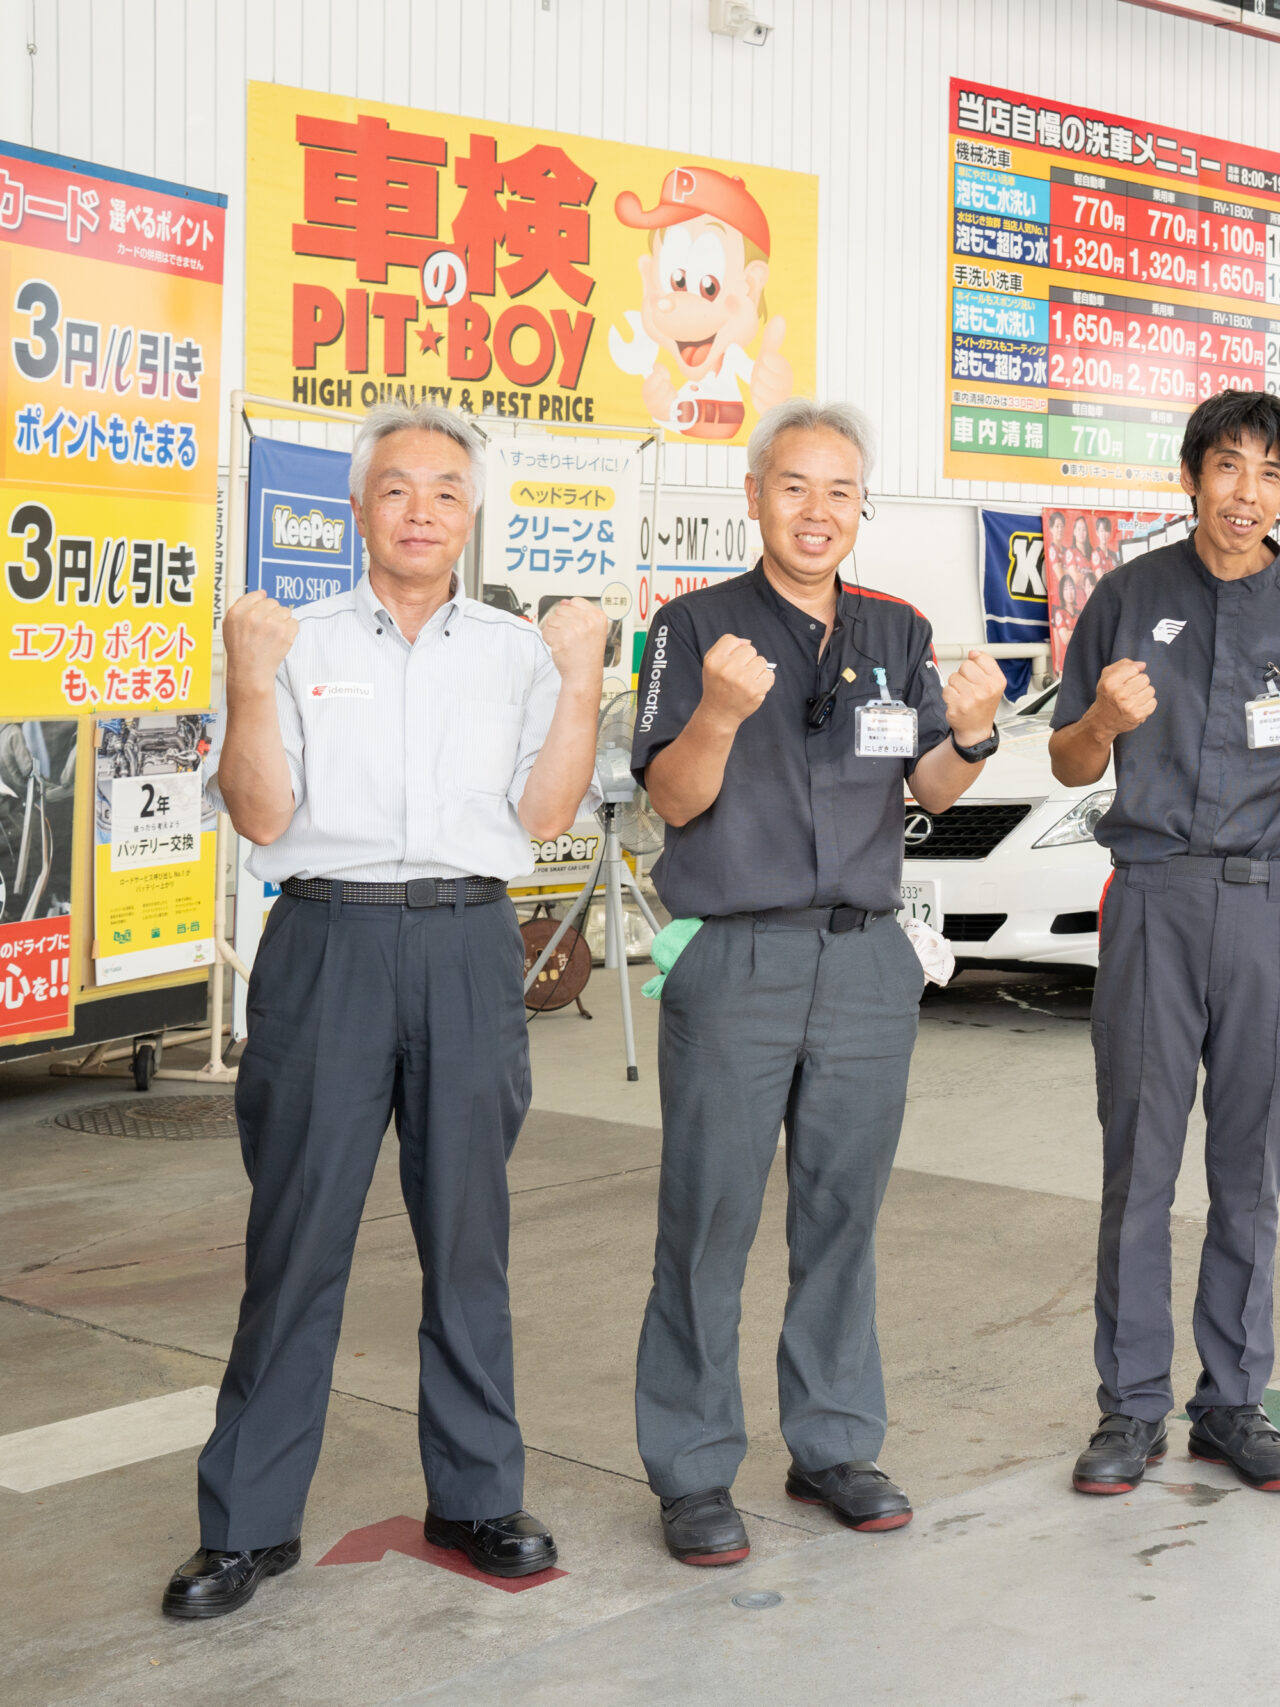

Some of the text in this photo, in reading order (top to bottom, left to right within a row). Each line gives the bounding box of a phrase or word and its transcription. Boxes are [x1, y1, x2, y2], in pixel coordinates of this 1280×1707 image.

[958, 90, 1221, 177] 当店自慢の洗車メニュー
[956, 141, 1011, 168] 機械洗車
[673, 167, 697, 203] P
[956, 179, 1036, 217] 泡もこ水洗い
[109, 198, 214, 251] 選べるポイント
[1073, 195, 1125, 232] 770円
[1148, 209, 1197, 245] 770円
[956, 225, 1048, 264] 泡もこ超はっ水
[1053, 235, 1124, 274] 1,320円
[1201, 220, 1264, 257] 1,100円
[954, 265, 1023, 293] 手洗い洗車
[1129, 248, 1197, 286] 1,320円
[1201, 261, 1264, 297] 1,650円
[955, 304, 1035, 338] 泡もこ水洗い
[1052, 310, 1124, 348] 1,650円
[1127, 321, 1196, 357] 2,200円
[954, 348, 1048, 385] 泡もこ超はっ水
[1200, 331, 1264, 367] 2,750円
[1051, 354, 1123, 391] 2,200円
[1127, 364, 1196, 398] 2,750円
[293, 376, 352, 408] HIGH
[460, 388, 474, 413] &
[539, 395, 594, 423] PRICE
[17, 408, 197, 467] ポイントもたまる
[954, 416, 1043, 449] 車内清掃
[1071, 424, 1122, 457] 770円
[1146, 433, 1182, 461] 770
[520, 487, 606, 507] ヘッドライト
[274, 507, 344, 551] KeePer
[505, 545, 616, 575] プロテクト
[1011, 538, 1048, 596] K
[275, 575, 341, 600] PRO SHOP
[328, 685, 370, 695] idemitsu
[639, 625, 668, 732] apollostation
[140, 783, 170, 818] 2年
[117, 833, 194, 857] バッテリー交換
[531, 834, 598, 862] eePer
